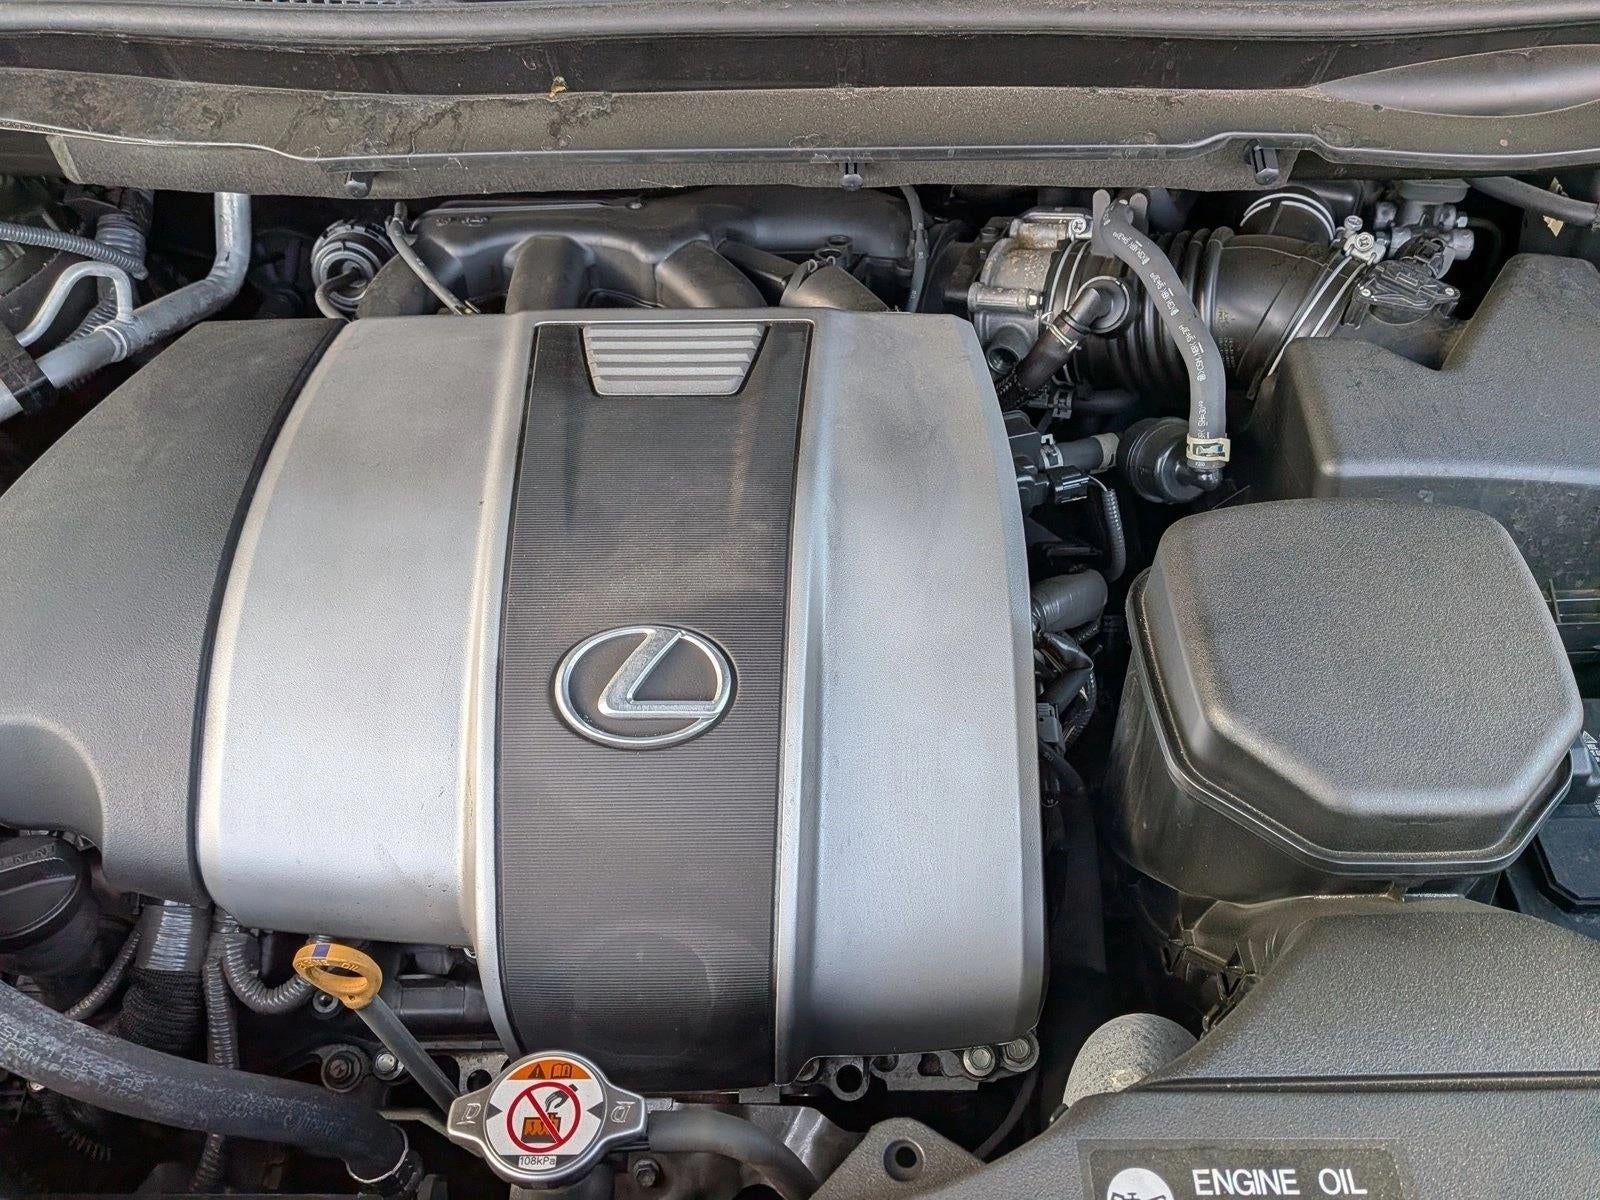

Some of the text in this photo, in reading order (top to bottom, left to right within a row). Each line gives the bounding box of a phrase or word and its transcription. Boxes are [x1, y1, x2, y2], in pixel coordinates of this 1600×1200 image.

[519, 1156, 556, 1166] 108kPa
[1192, 1168, 1368, 1196] ENGINE OIL
